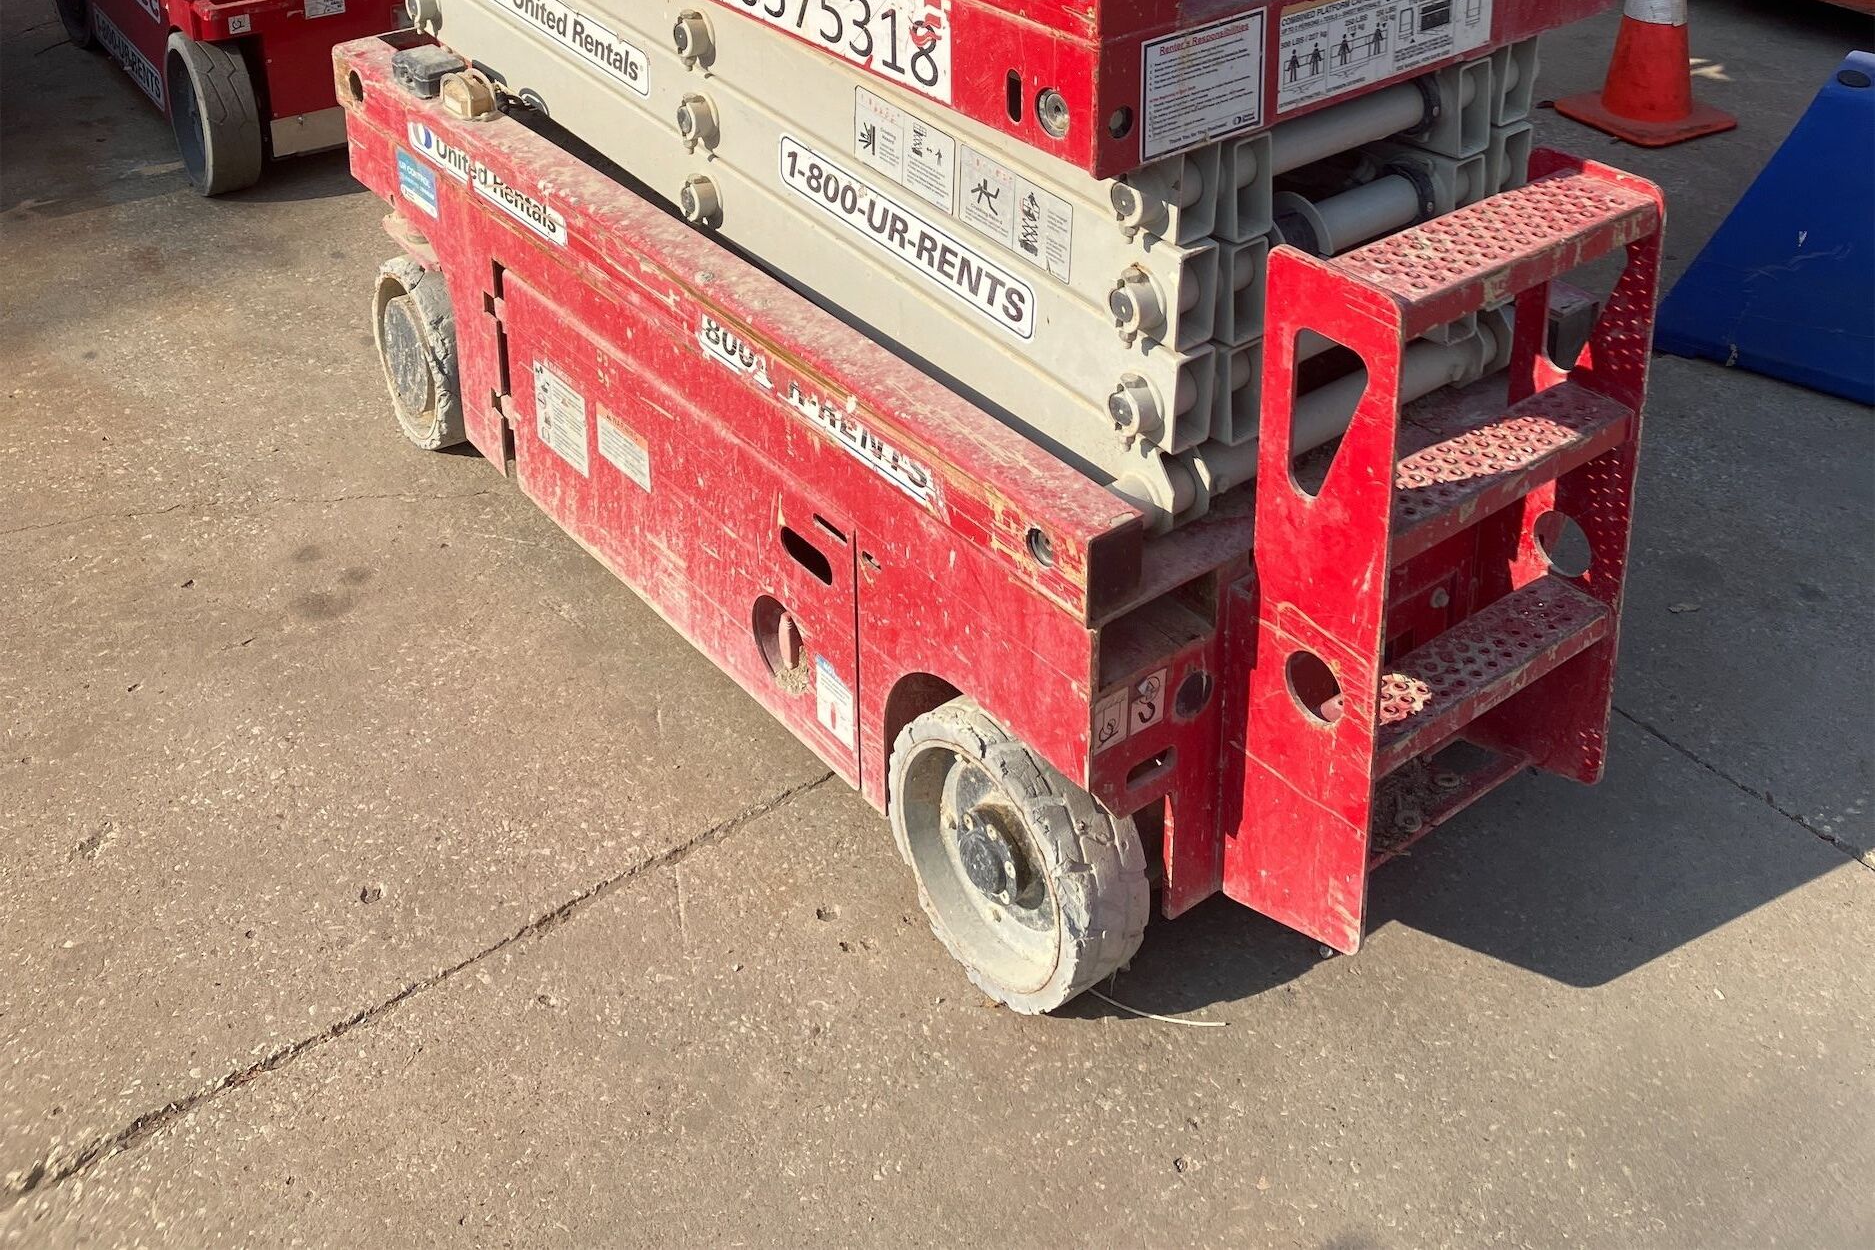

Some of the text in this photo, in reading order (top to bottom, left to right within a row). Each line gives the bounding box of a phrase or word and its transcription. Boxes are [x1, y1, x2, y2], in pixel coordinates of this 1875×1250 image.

[571, 17, 640, 82] Rentals
[435, 135, 488, 186] United
[492, 173, 558, 235] Rentals
[786, 150, 1026, 323] 1-800-UR-RENTS
